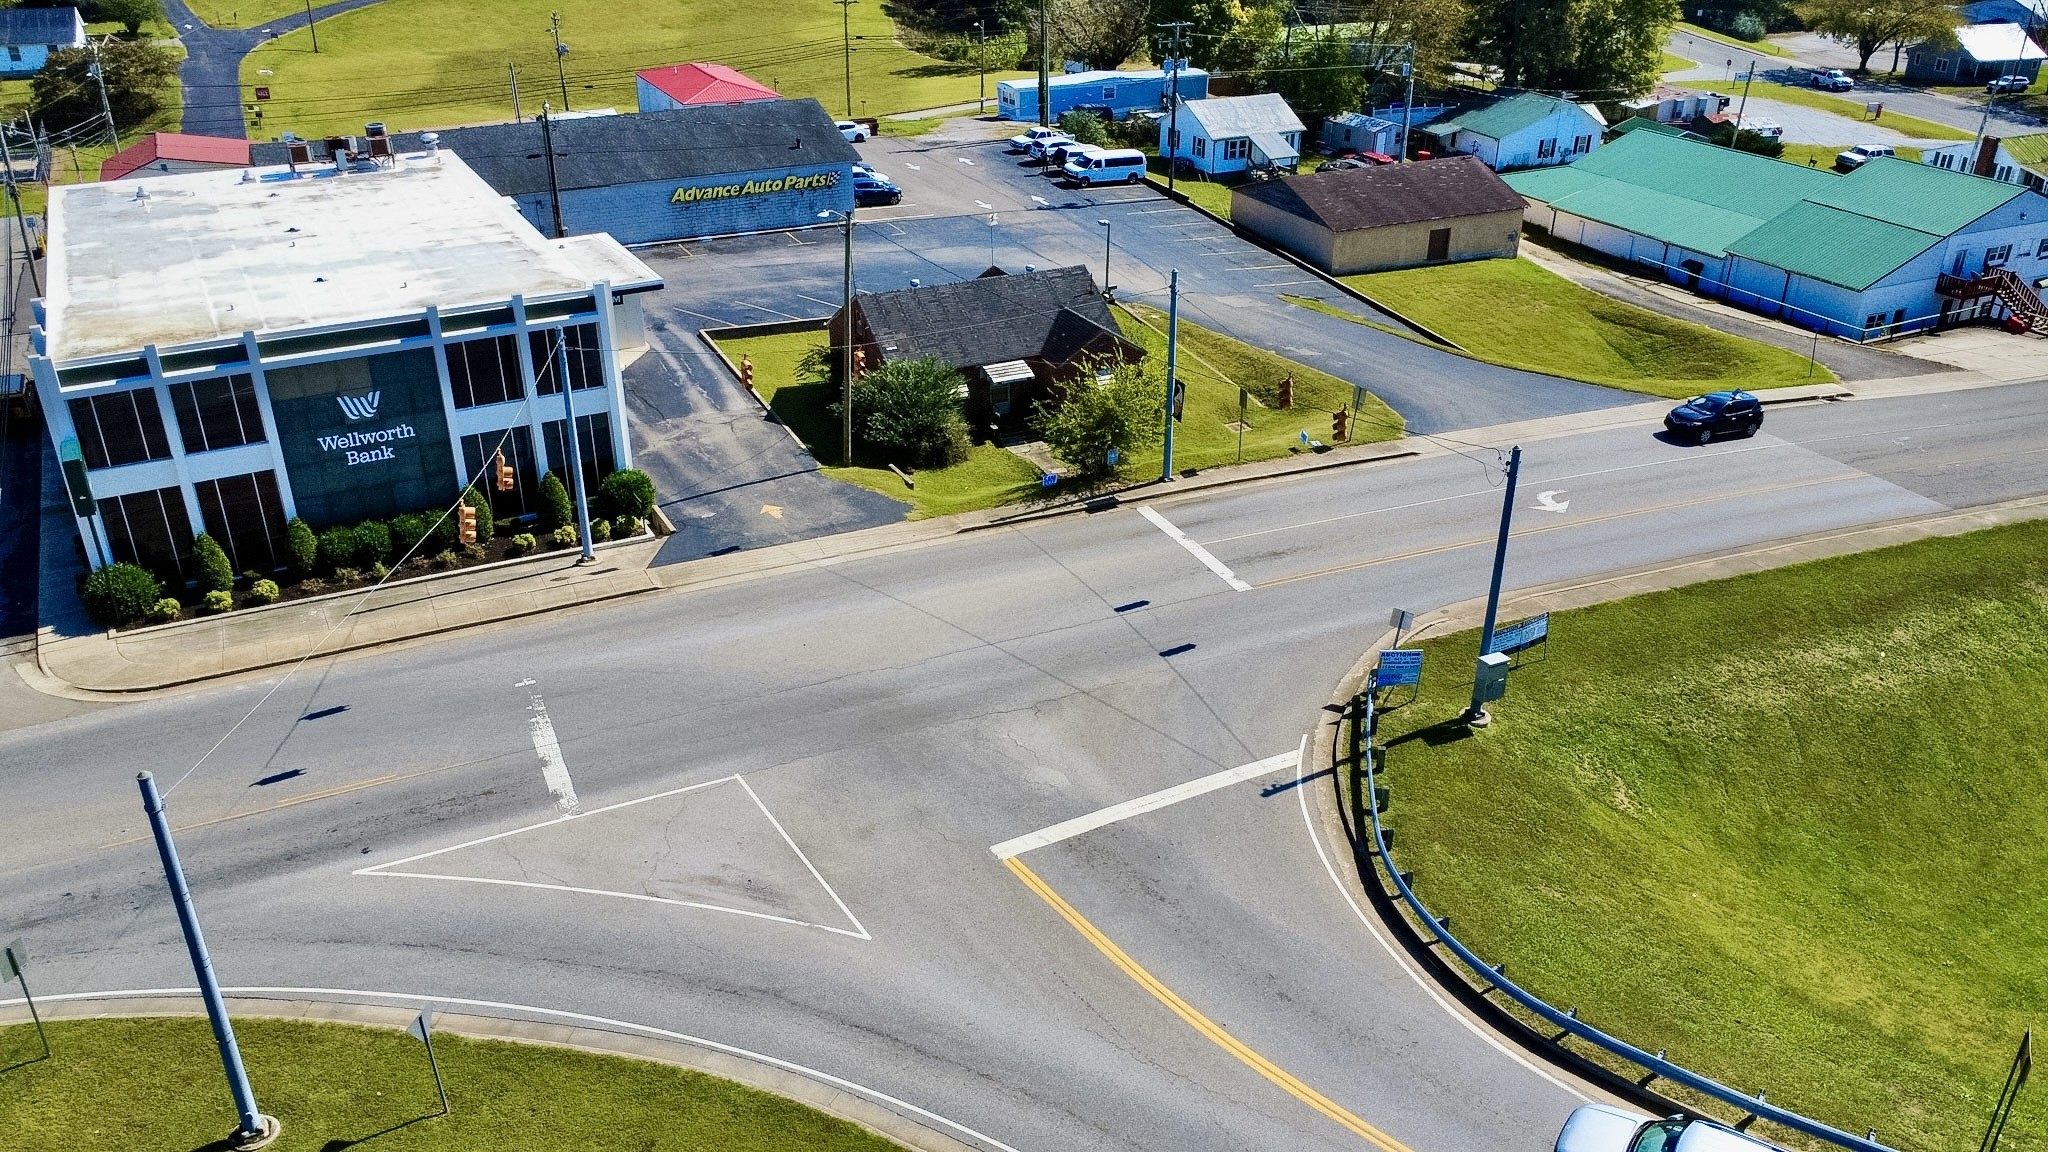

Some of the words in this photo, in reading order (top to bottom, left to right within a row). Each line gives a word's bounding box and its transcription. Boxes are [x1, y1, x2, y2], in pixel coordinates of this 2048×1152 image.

[671, 185, 739, 203] Advance
[741, 178, 783, 195] Auto
[784, 173, 827, 189] Parts
[317, 423, 416, 451] Wellworth
[345, 445, 395, 466] Bank
